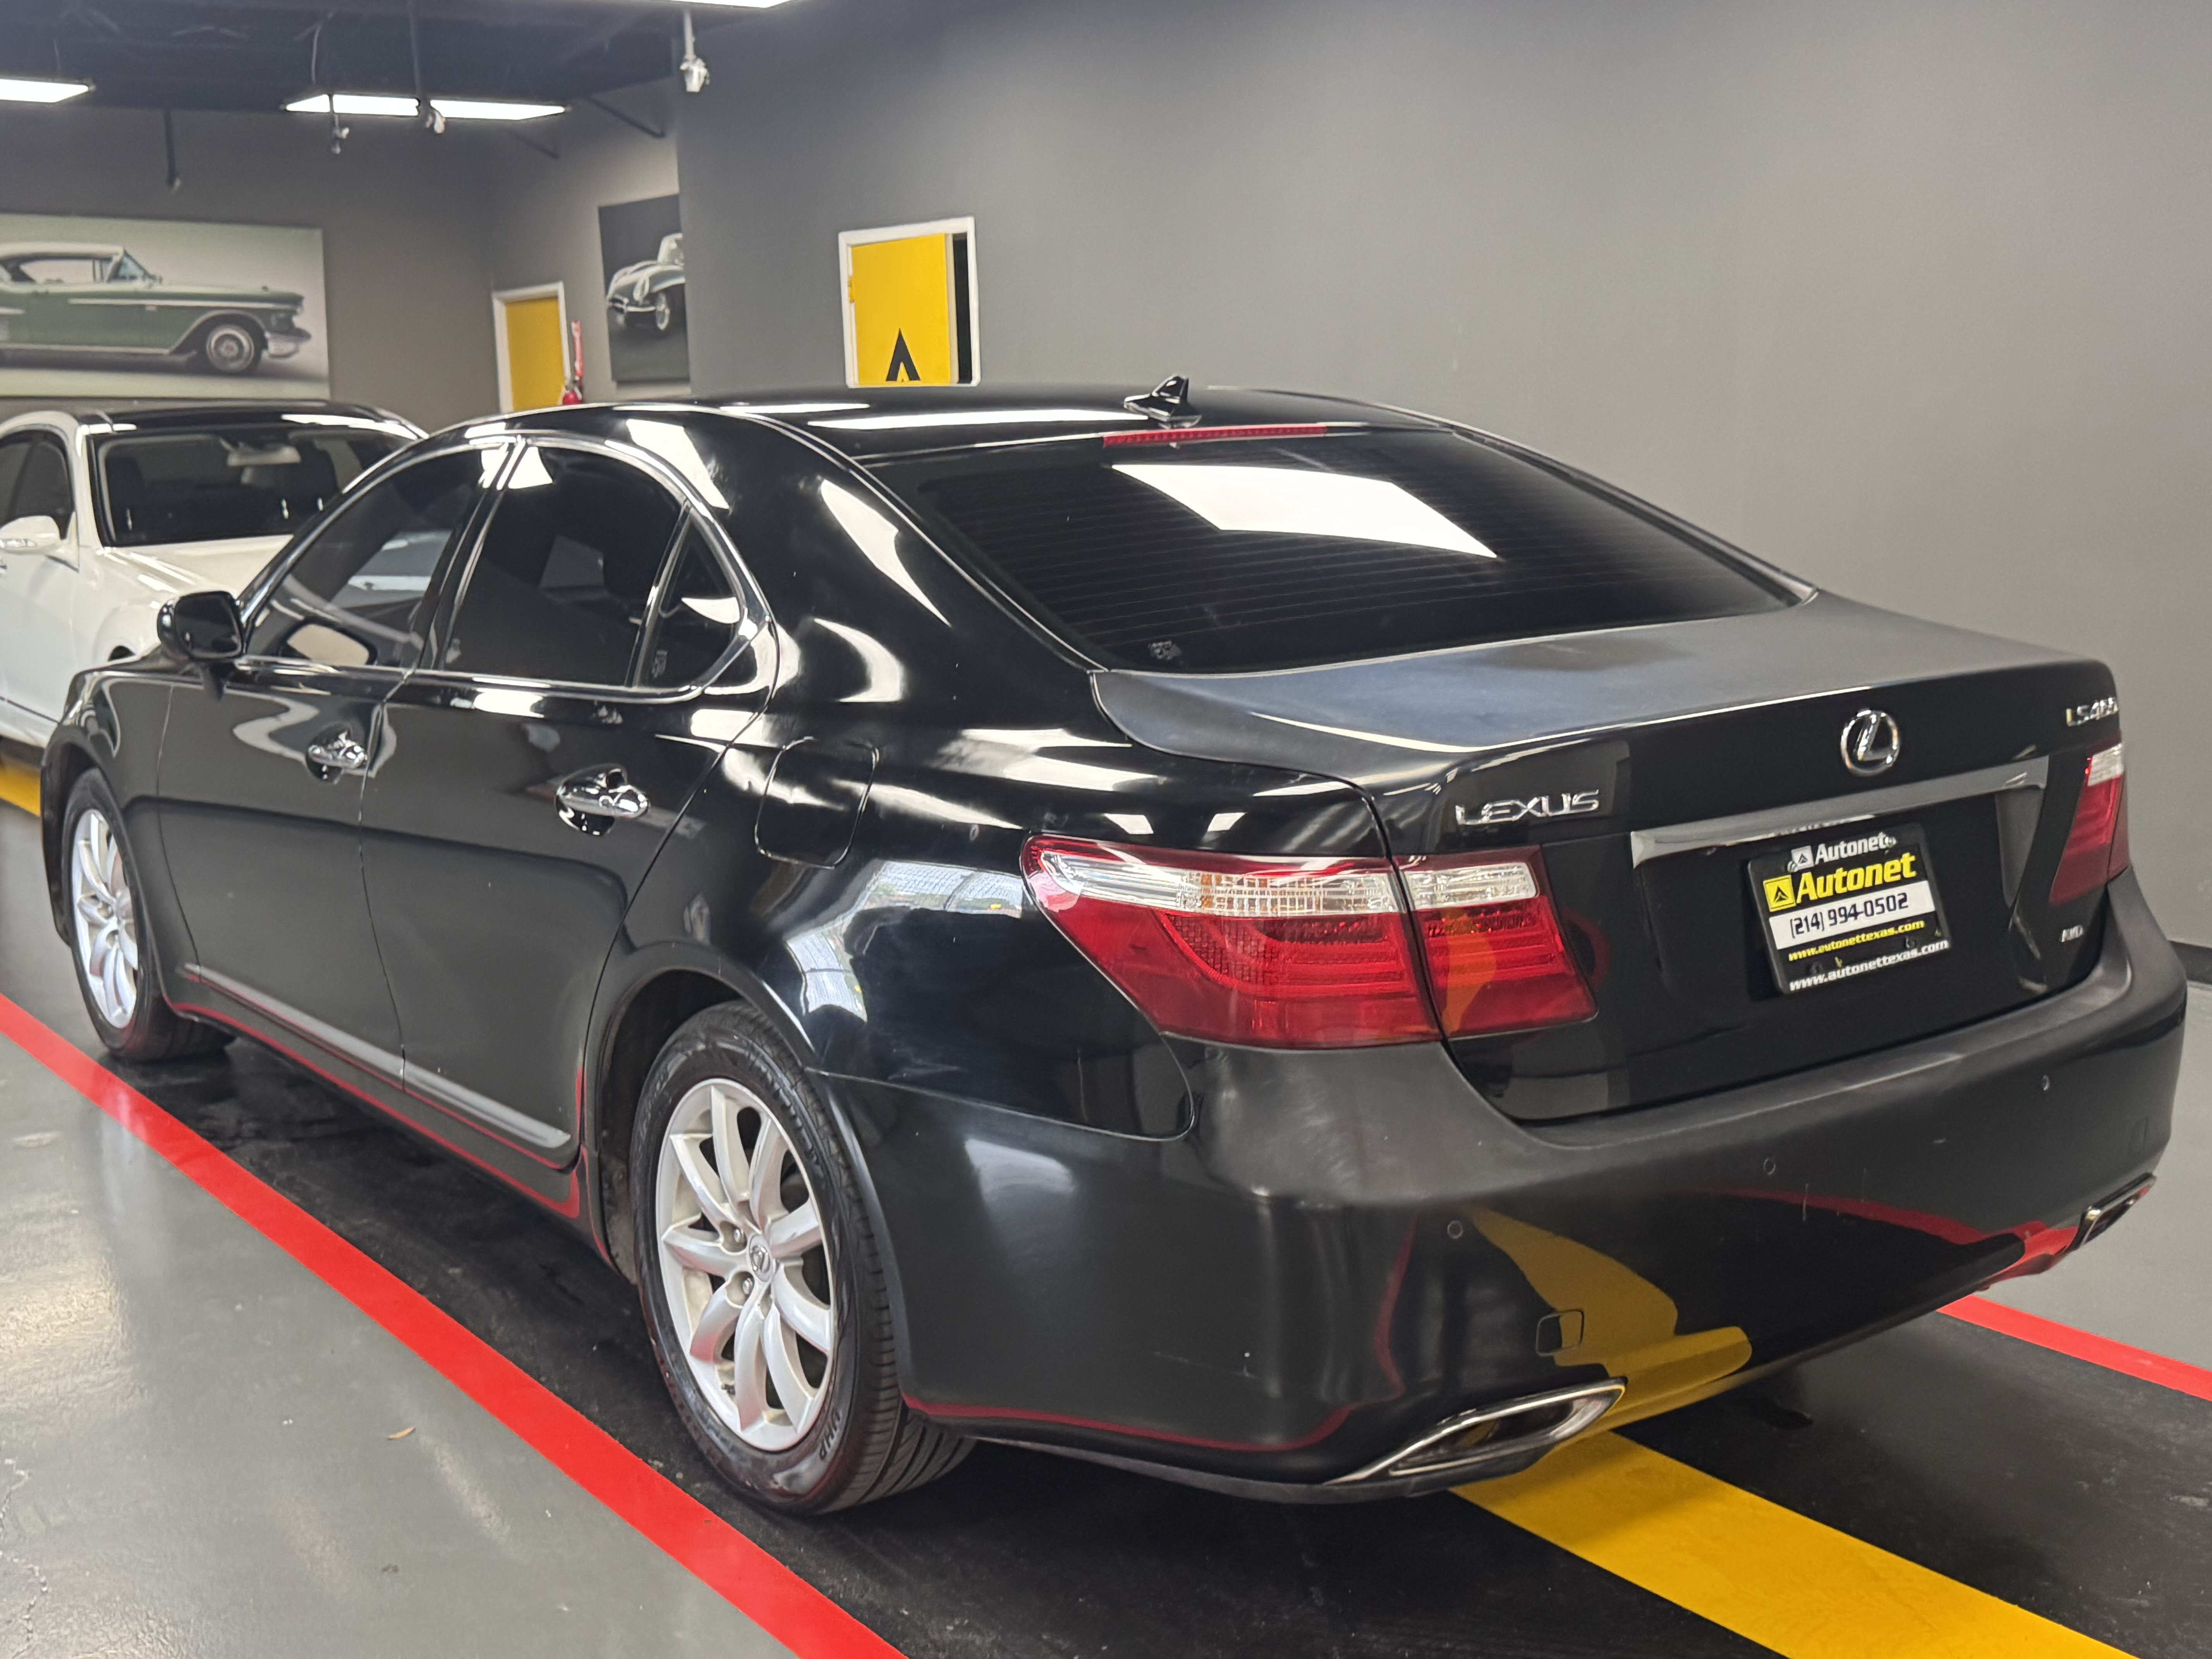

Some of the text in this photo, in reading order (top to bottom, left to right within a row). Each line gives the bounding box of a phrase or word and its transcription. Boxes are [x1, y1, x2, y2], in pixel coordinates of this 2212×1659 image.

[1455, 789, 1599, 825] LEXUS
[1815, 831, 1887, 865] Autonet
[1796, 852, 1917, 904] Autonet
[1790, 892, 1909, 939] (214) 994-0502
[1788, 920, 1925, 962] www.autonettexas.com
[1790, 939, 1949, 991] www.autonettexas.com
